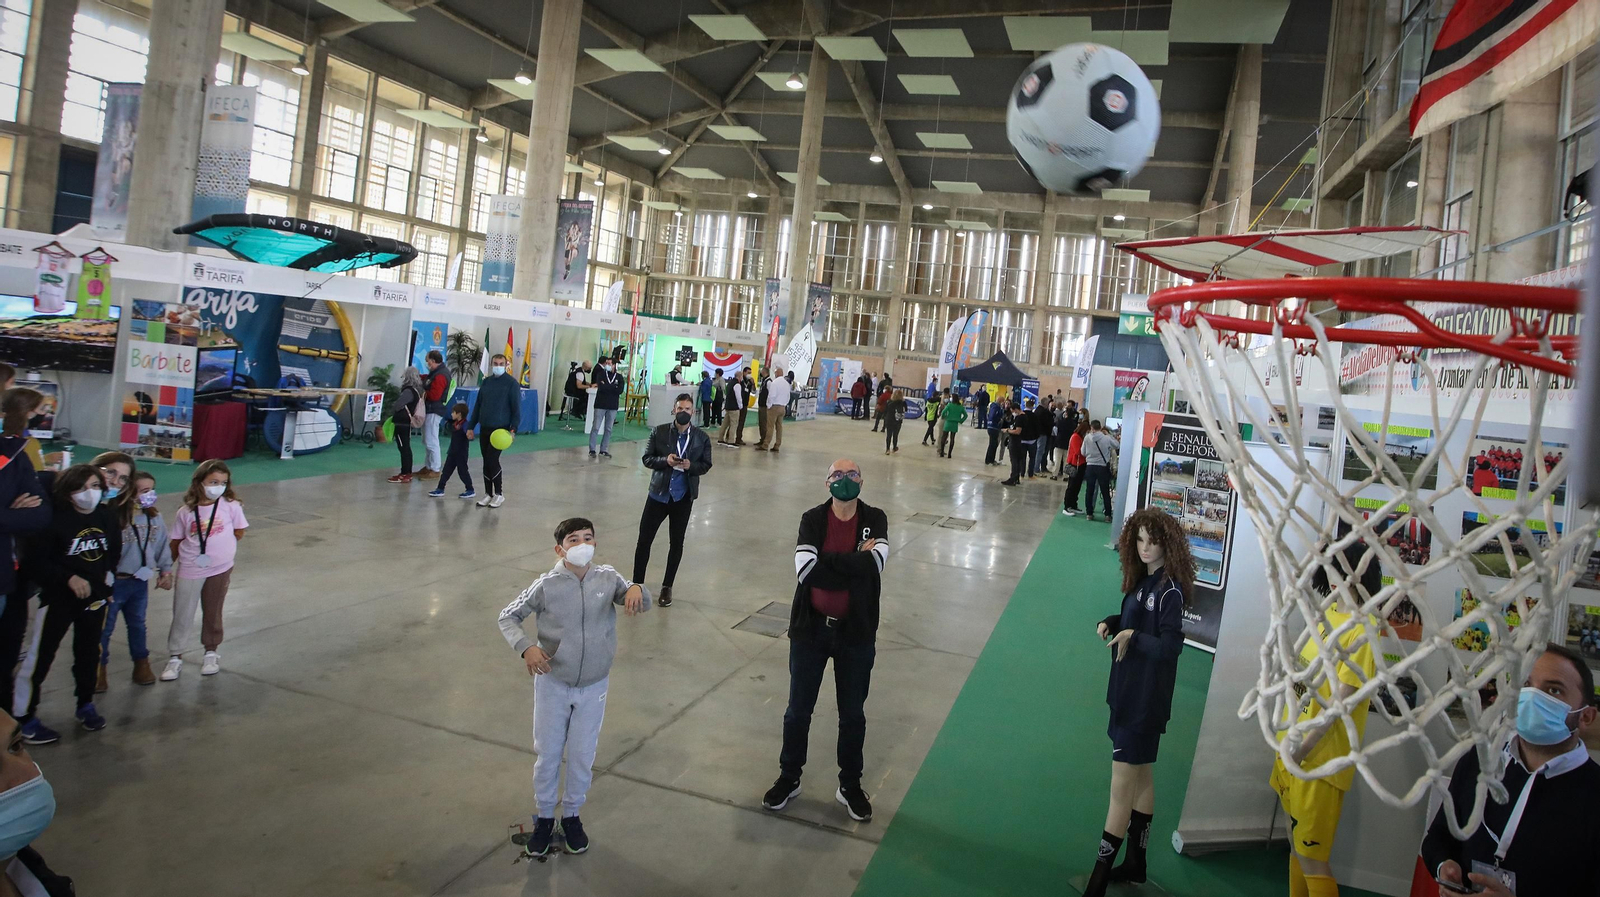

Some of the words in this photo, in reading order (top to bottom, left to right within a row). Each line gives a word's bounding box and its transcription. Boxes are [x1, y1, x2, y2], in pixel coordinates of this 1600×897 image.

[209, 97, 250, 111] IFECA
[493, 202, 521, 210] IFECA
[267, 217, 333, 237] NORTH
[206, 270, 245, 285] TARIFA
[305, 281, 322, 291] TARIFA
[382, 292, 408, 303] TARIFA
[131, 348, 193, 374] Barbate
[1163, 441, 1174, 452] ES
